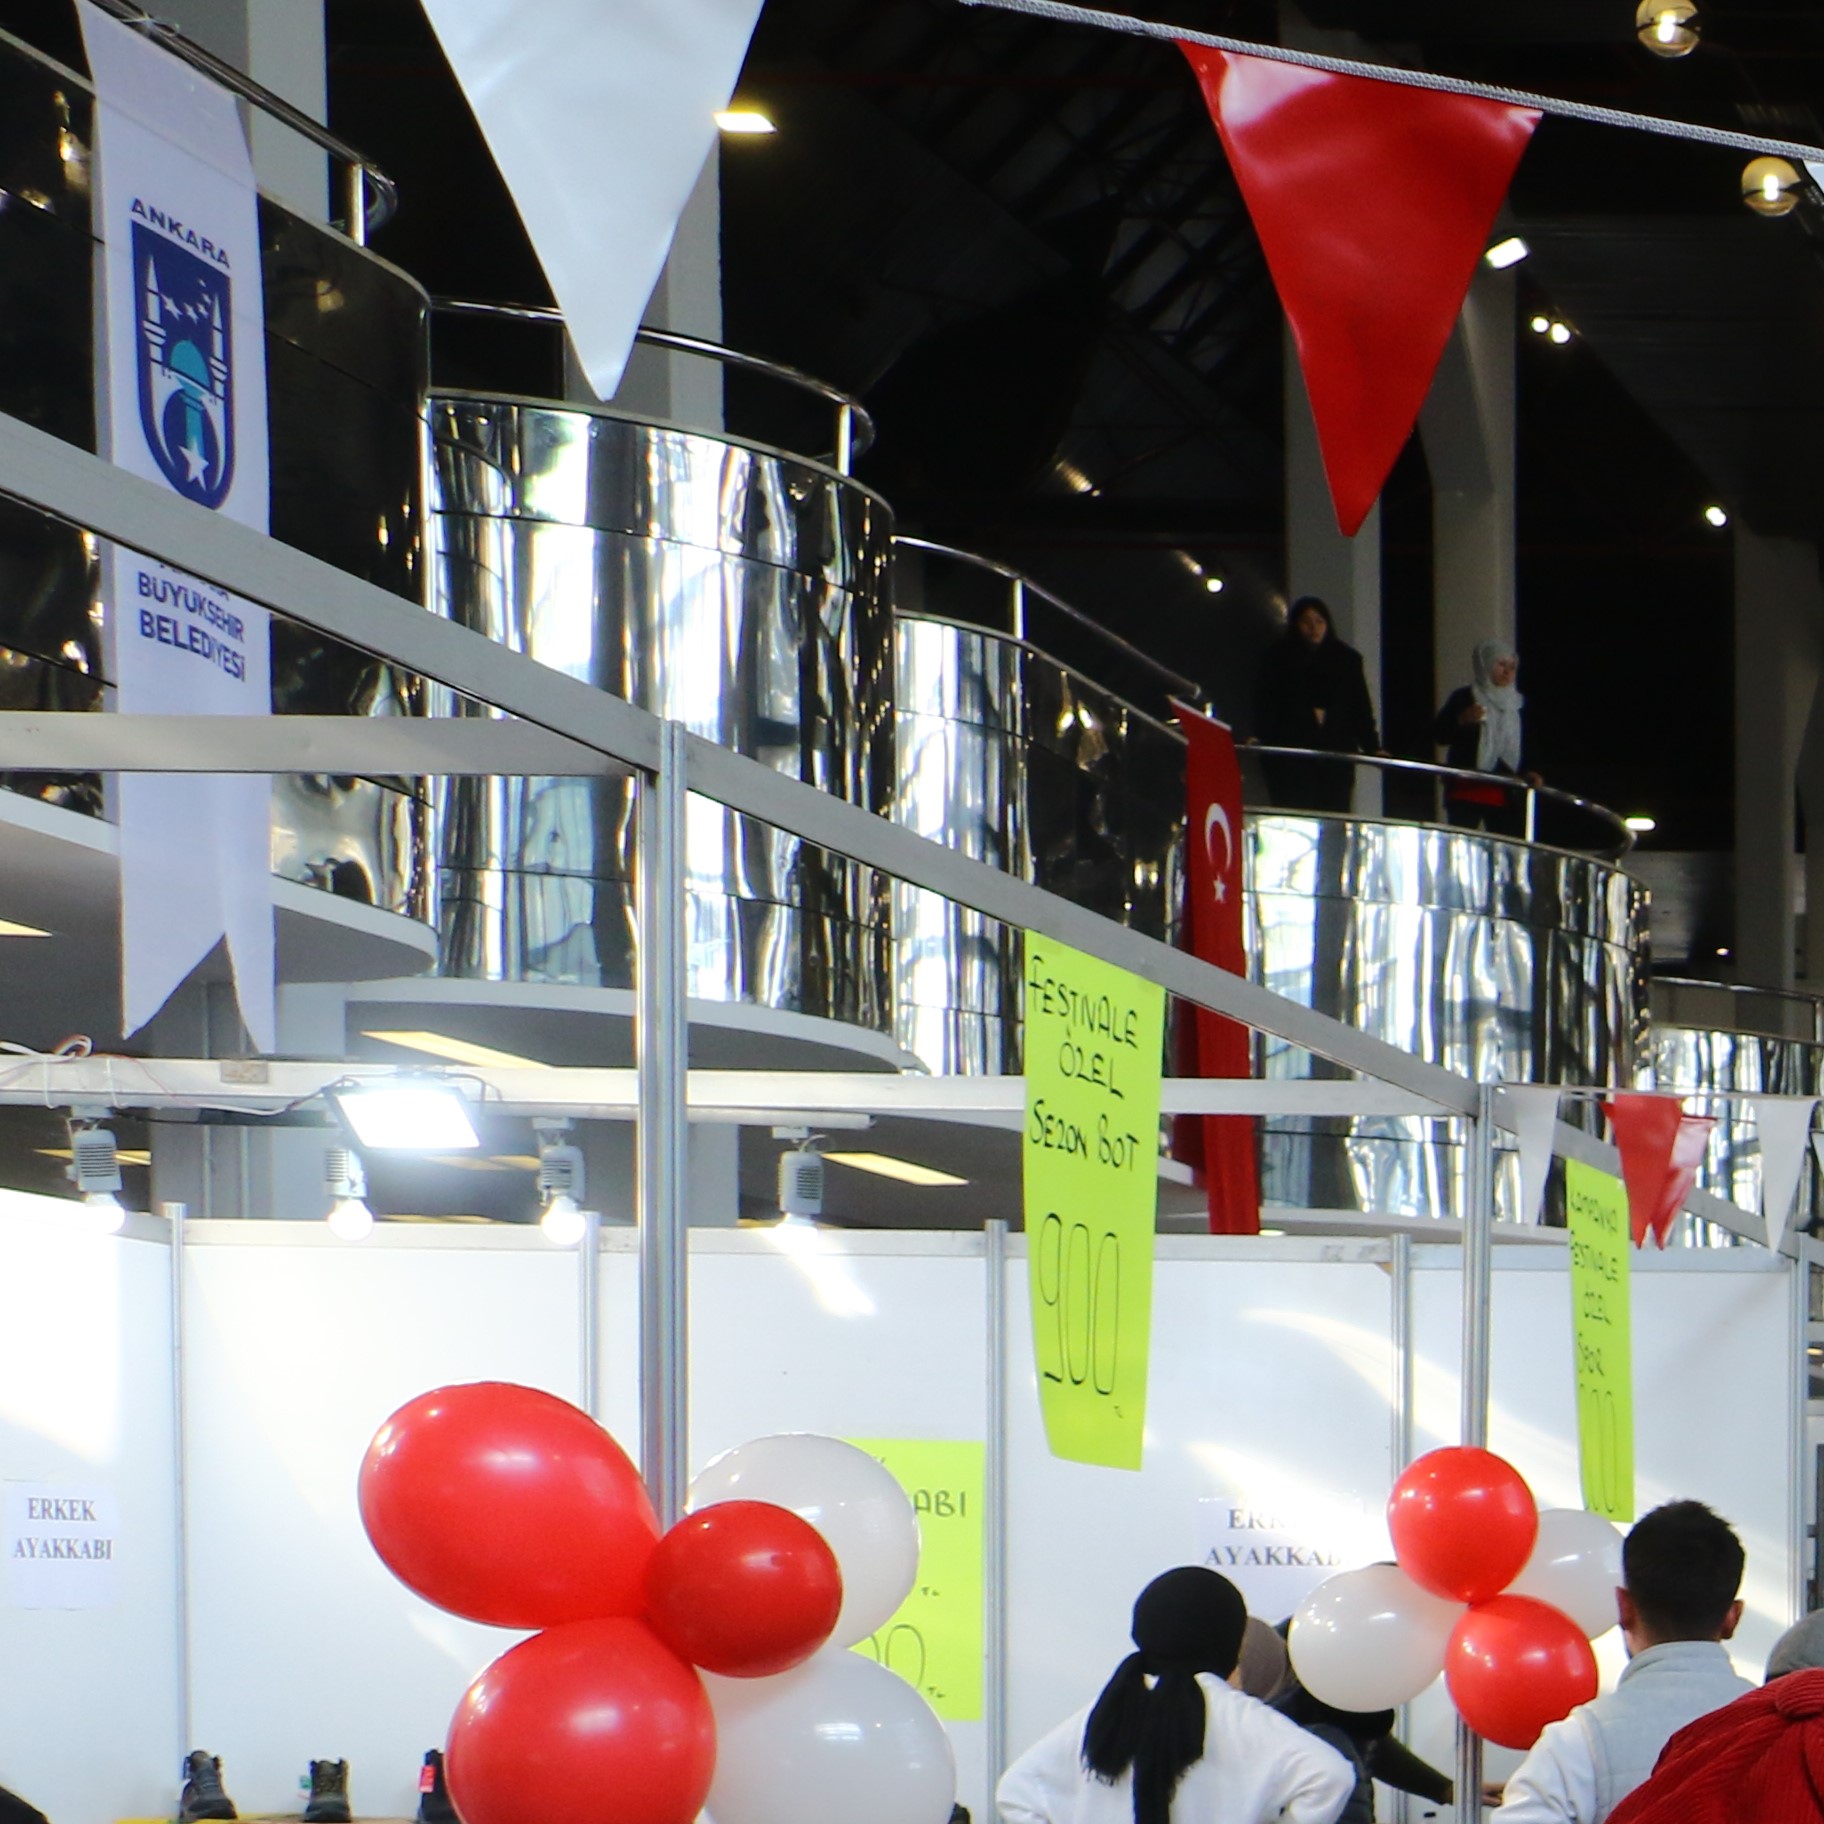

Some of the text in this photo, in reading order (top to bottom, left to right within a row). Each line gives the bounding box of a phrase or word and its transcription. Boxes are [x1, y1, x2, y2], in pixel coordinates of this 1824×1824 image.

[131, 198, 230, 269] ANKARA
[1099, 1114, 1139, 1171] BOT
[1039, 1213, 1119, 1395] 900
[28, 1497, 97, 1521] ERKEK
[14, 1538, 112, 1560] AYAKKABI
